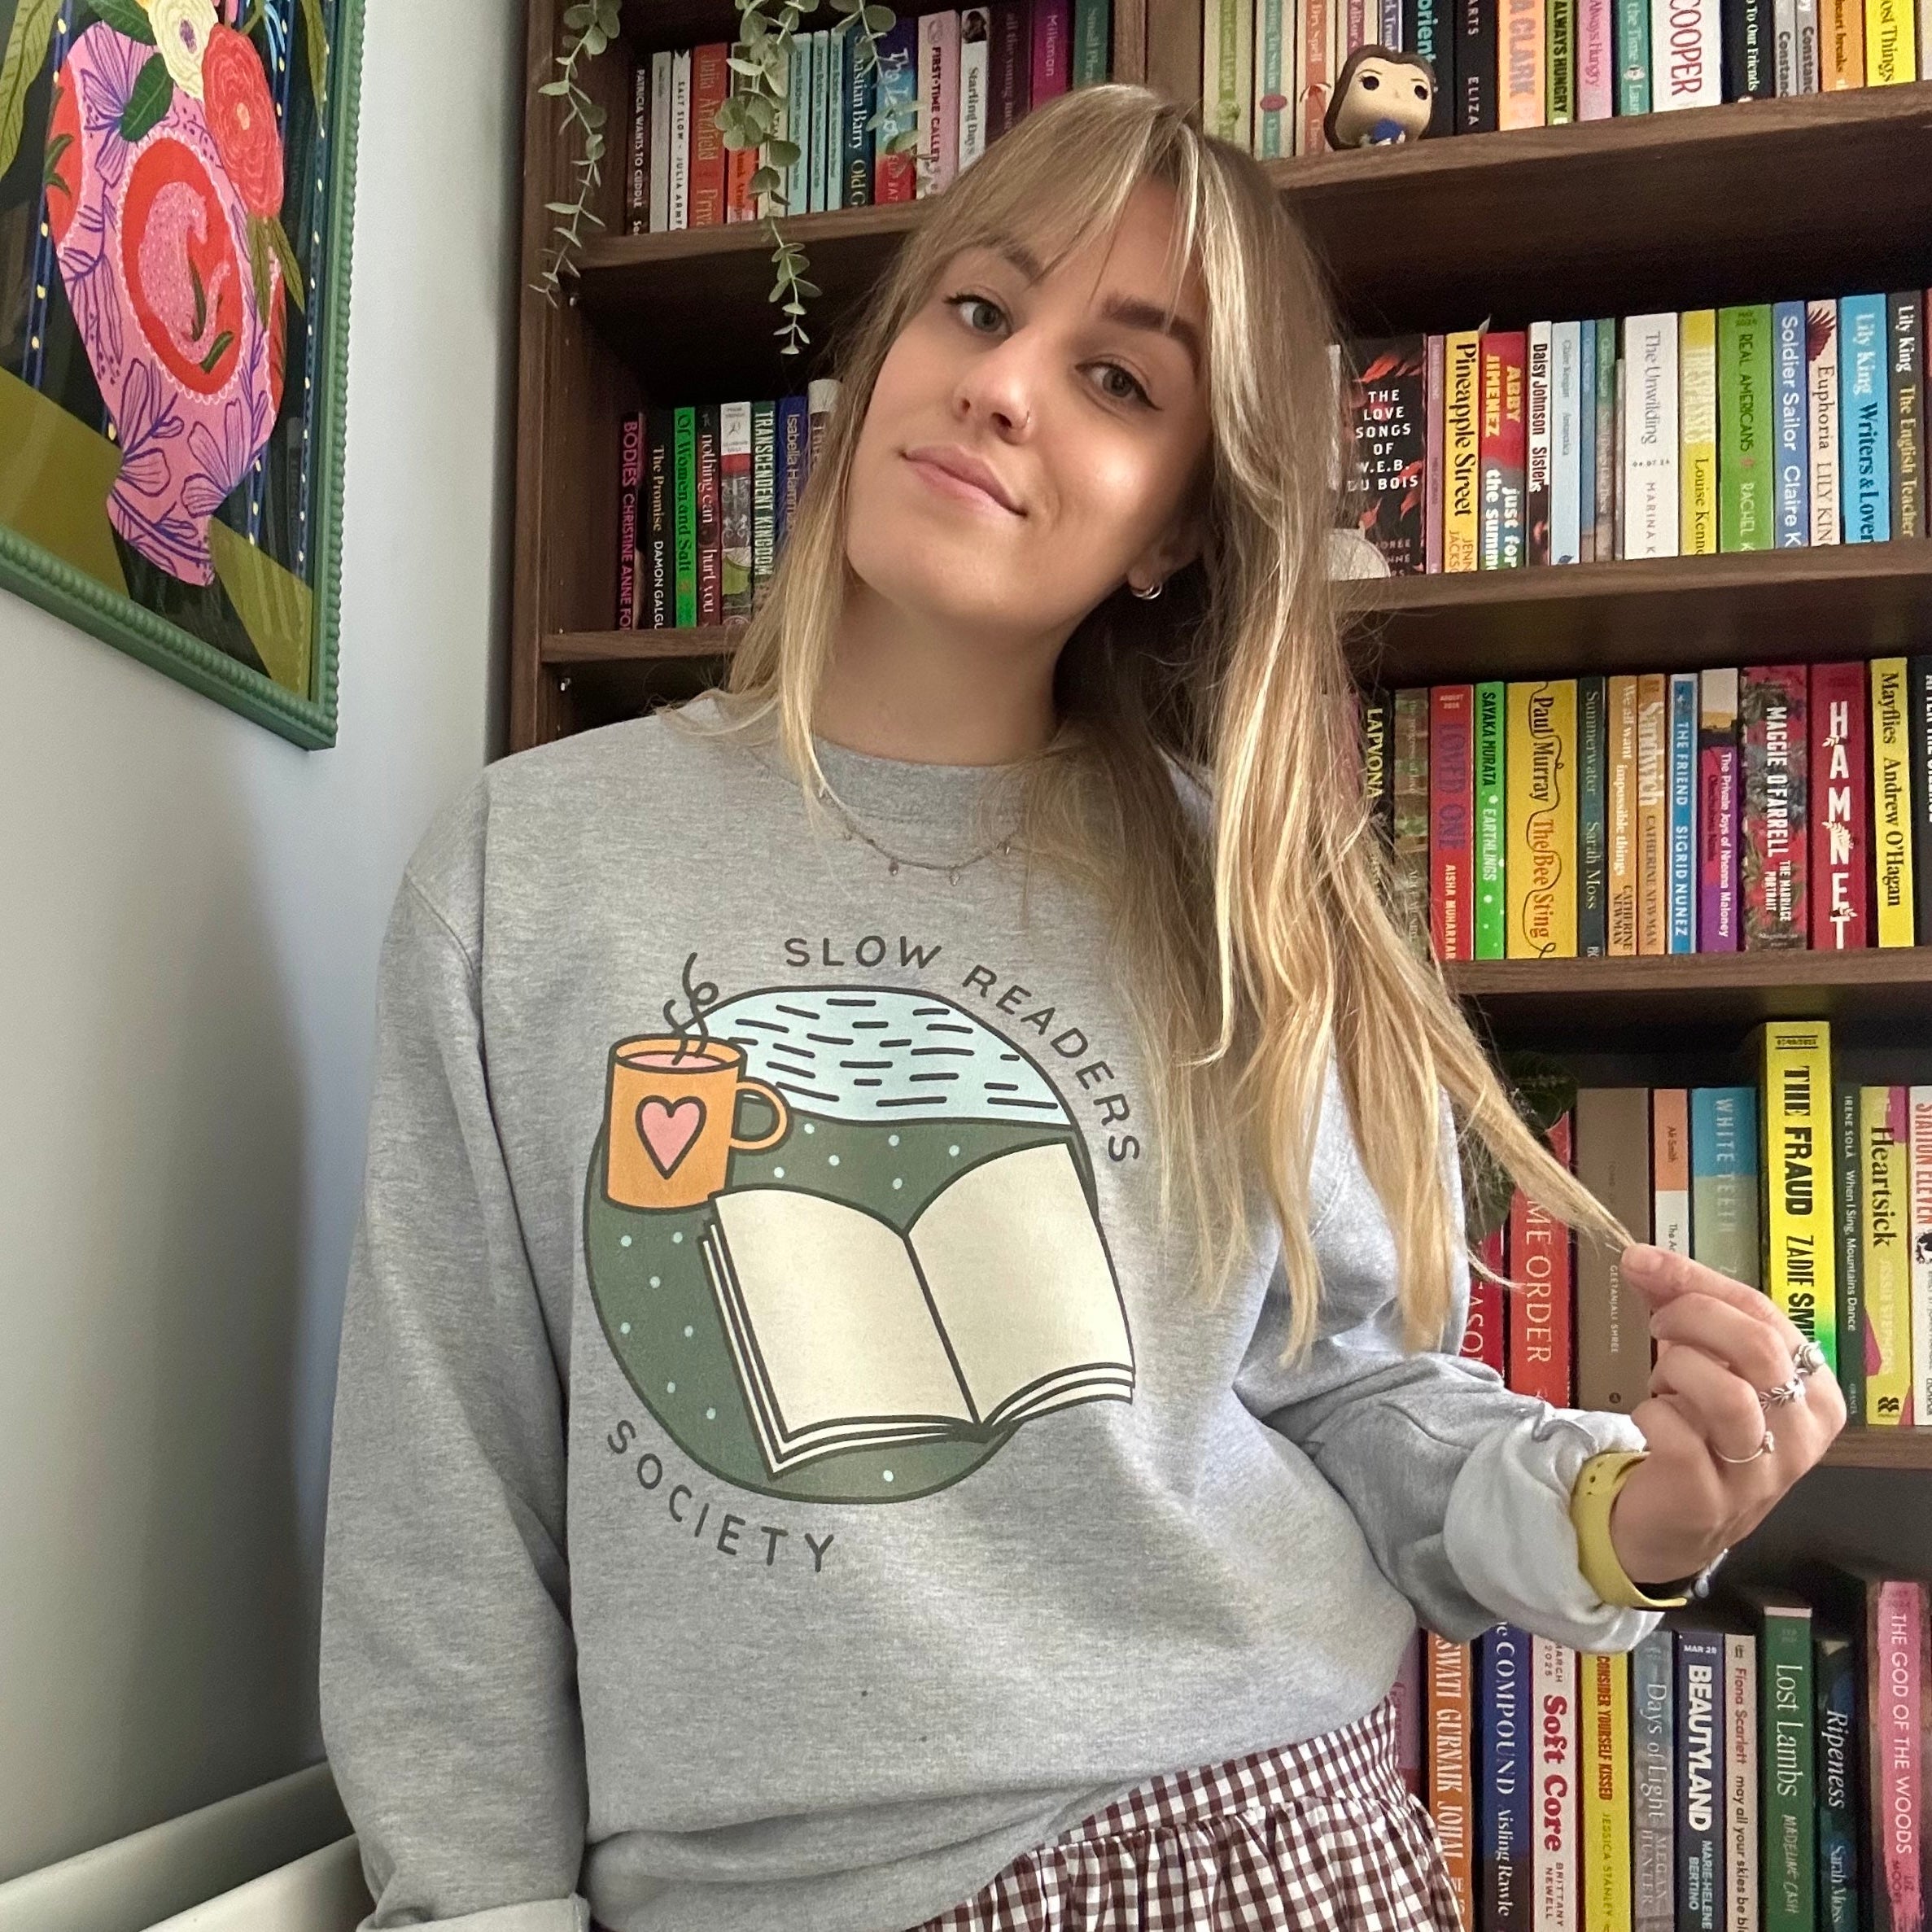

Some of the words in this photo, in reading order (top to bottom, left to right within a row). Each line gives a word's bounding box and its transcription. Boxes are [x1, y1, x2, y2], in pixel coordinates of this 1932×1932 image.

[1553, 1, 1567, 55] ALWAYS
[1745, 6, 1758, 21] To
[1746, 24, 1759, 45] Our
[1045, 15, 1058, 76] Milkman
[1509, 17, 1536, 98] CLARK
[1584, 43, 1602, 88] Hungry
[1628, 30, 1641, 60] Time
[1746, 48, 1761, 91] Friends
[1834, 32, 1847, 73] breaks
[1877, 25, 1898, 83] Things
[635, 69, 645, 113] PATRICIA
[1467, 76, 1480, 125] ELIZA
[1554, 59, 1567, 113] HUNGRY
[849, 110, 868, 149] Barry
[850, 160, 867, 189] Old
[1853, 313, 1875, 345] Lily
[1895, 304, 1915, 334] Lily
[1531, 343, 1548, 378] Daisy
[1645, 331, 1661, 364] The
[1739, 334, 1753, 364] REAL
[1781, 316, 1798, 387] Soldier
[1895, 337, 1915, 373] King
[1368, 389, 1400, 404] THE
[1449, 343, 1476, 448] Pineapple
[1484, 353, 1501, 438] JIMENEZ
[1506, 365, 1521, 423] ABBY
[1852, 352, 1876, 396] King
[1362, 405, 1405, 421] LOVE
[1532, 380, 1549, 435] Johnson
[1641, 366, 1661, 445] Unwilding
[1739, 374, 1755, 452] AMERICANS
[1783, 392, 1800, 452] Sailor
[1812, 365, 1834, 450] Euphoria
[1899, 384, 1916, 414] The
[676, 414, 692, 435] Of
[786, 413, 800, 465] Isabella
[1355, 422, 1411, 439] SONGS
[1373, 442, 1394, 455] OF
[1858, 402, 1878, 475] Writers
[1896, 418, 1917, 474] English
[622, 422, 638, 487] BODIES
[652, 445, 665, 472] The
[677, 442, 693, 506] Women
[697, 434, 717, 492] nothing
[754, 410, 775, 510] TRANSCENDENT
[1529, 447, 1548, 493] Sisters
[652, 476, 665, 532] Promise
[1378, 474, 1418, 491] BOIS
[1454, 452, 1476, 517] Street
[1485, 469, 1501, 503] the
[1694, 458, 1710, 508] Louise
[1783, 466, 1801, 527] Claire
[1816, 461, 1831, 501] LILY
[621, 494, 636, 562] CHRISTINE
[678, 505, 693, 535] and
[702, 494, 714, 523] can
[1501, 487, 1520, 528] just
[1646, 482, 1656, 540] MARINA
[1739, 483, 1755, 535] RACHEL
[1900, 475, 1917, 537] Teacher
[653, 540, 664, 587] DAMON
[678, 540, 693, 574] Salt
[702, 549, 718, 583] hurt
[754, 517, 775, 576] KINGDOM
[1504, 535, 1520, 568] for
[619, 566, 633, 605] ANNE
[700, 586, 715, 613] you
[1481, 692, 1497, 737] SAYAKA
[1532, 697, 1554, 733] Paul
[1877, 672, 1900, 745] Mayflies
[1366, 707, 1383, 798] LAPVONA
[1585, 692, 1599, 795] Summerwater
[1621, 728, 1633, 759] want
[1637, 701, 1666, 807] Sandwich
[1676, 722, 1688, 751] THE
[1766, 706, 1787, 766] MAGGIE
[1482, 741, 1497, 786] MURATA
[1528, 741, 1554, 802] Murray
[1676, 754, 1689, 806] FRIEND
[1720, 753, 1732, 772] The
[1613, 764, 1628, 833] impossible
[1720, 775, 1732, 810] Private
[1766, 774, 1789, 858] O'FARRELL
[1883, 758, 1902, 827] Andrew
[1482, 808, 1497, 881] EARTHLINGS
[1533, 820, 1554, 847] The
[1585, 821, 1600, 864] Sarah
[1719, 814, 1731, 835] Joys
[1720, 836, 1731, 846] of
[1829, 701, 1851, 950] HAMNET
[1533, 854, 1554, 885] Bee
[1613, 836, 1628, 876] things
[1676, 825, 1689, 879] SIGRID
[1779, 860, 1791, 876] THE
[1880, 832, 1903, 907] O'Hagan
[1445, 863, 1457, 896] AISHA
[1586, 868, 1601, 910] Moss
[1764, 871, 1777, 911] PORTRAIT
[1445, 899, 1457, 959] MUHARRAR
[1529, 894, 1554, 938] Sting
[1613, 893, 1624, 945] NEWMAN
[1622, 885, 1633, 950] CATHERINE
[1676, 883, 1689, 936] NUNEZ
[1718, 891, 1731, 938] Maloney
[785, 935, 942, 970] SLOW
[962, 964, 1141, 1162] READERS
[1784, 1065, 1813, 1117] THE
[1844, 1095, 1853, 1127] IRENE
[1715, 1098, 1736, 1163] WHITE
[1785, 1126, 1814, 1215] FRAUD
[1846, 1169, 1857, 1201] When
[1870, 1126, 1898, 1248] Heartsick
[1786, 1235, 1815, 1287] ZADIE
[1846, 1237, 1857, 1295] Mountains
[1526, 1255, 1552, 1363] ORDER
[1847, 1296, 1858, 1331] Dance
[608, 1419, 835, 1572] SOCIETY
[1890, 1613, 1907, 1645] THE
[1597, 1655, 1613, 1707] CONSIDER
[1733, 1667, 1747, 1706] Fiona
[1776, 1664, 1803, 1711] Lost
[1890, 1651, 1908, 1697] GOD
[1496, 1641, 1516, 1795] COMPOUND
[1542, 1694, 1567, 1764] Soft
[1639, 1683, 1668, 1733] Days
[1892, 1704, 1908, 1730] OF
[1436, 1709, 1462, 1793] GURNAIK
[1598, 1710, 1613, 1760] YOURSELF
[1647, 1742, 1665, 1758] of
[1688, 1663, 1713, 1832] BEAUTYLAND
[1735, 1709, 1748, 1765] Scarlett
[1776, 1720, 1804, 1796] Lambs
[1821, 1709, 1849, 1808] Ripeness
[1893, 1737, 1910, 1769] THE
[1598, 1763, 1614, 1801] KISSED
[1640, 1765, 1668, 1818] Light
[1733, 1775, 1745, 1803] may
[1542, 1773, 1567, 1851] Core
[1602, 1812, 1613, 1860] JESSICA
[1735, 1806, 1747, 1824] all
[1895, 1776, 1912, 1854] WOODS
[1733, 1827, 1746, 1857] your
[1829, 1842, 1846, 1882] Sarah
[1497, 1864, 1514, 1917] Rawle
[1545, 1867, 1554, 1920] NEWELL
[1555, 1862, 1564, 1927] BRITTANY
[1688, 1856, 1700, 1911] BERTINO
[1736, 1860, 1748, 1892] skies
[1736, 1896, 1748, 1913] be
[1830, 1886, 1846, 1922] Moss
